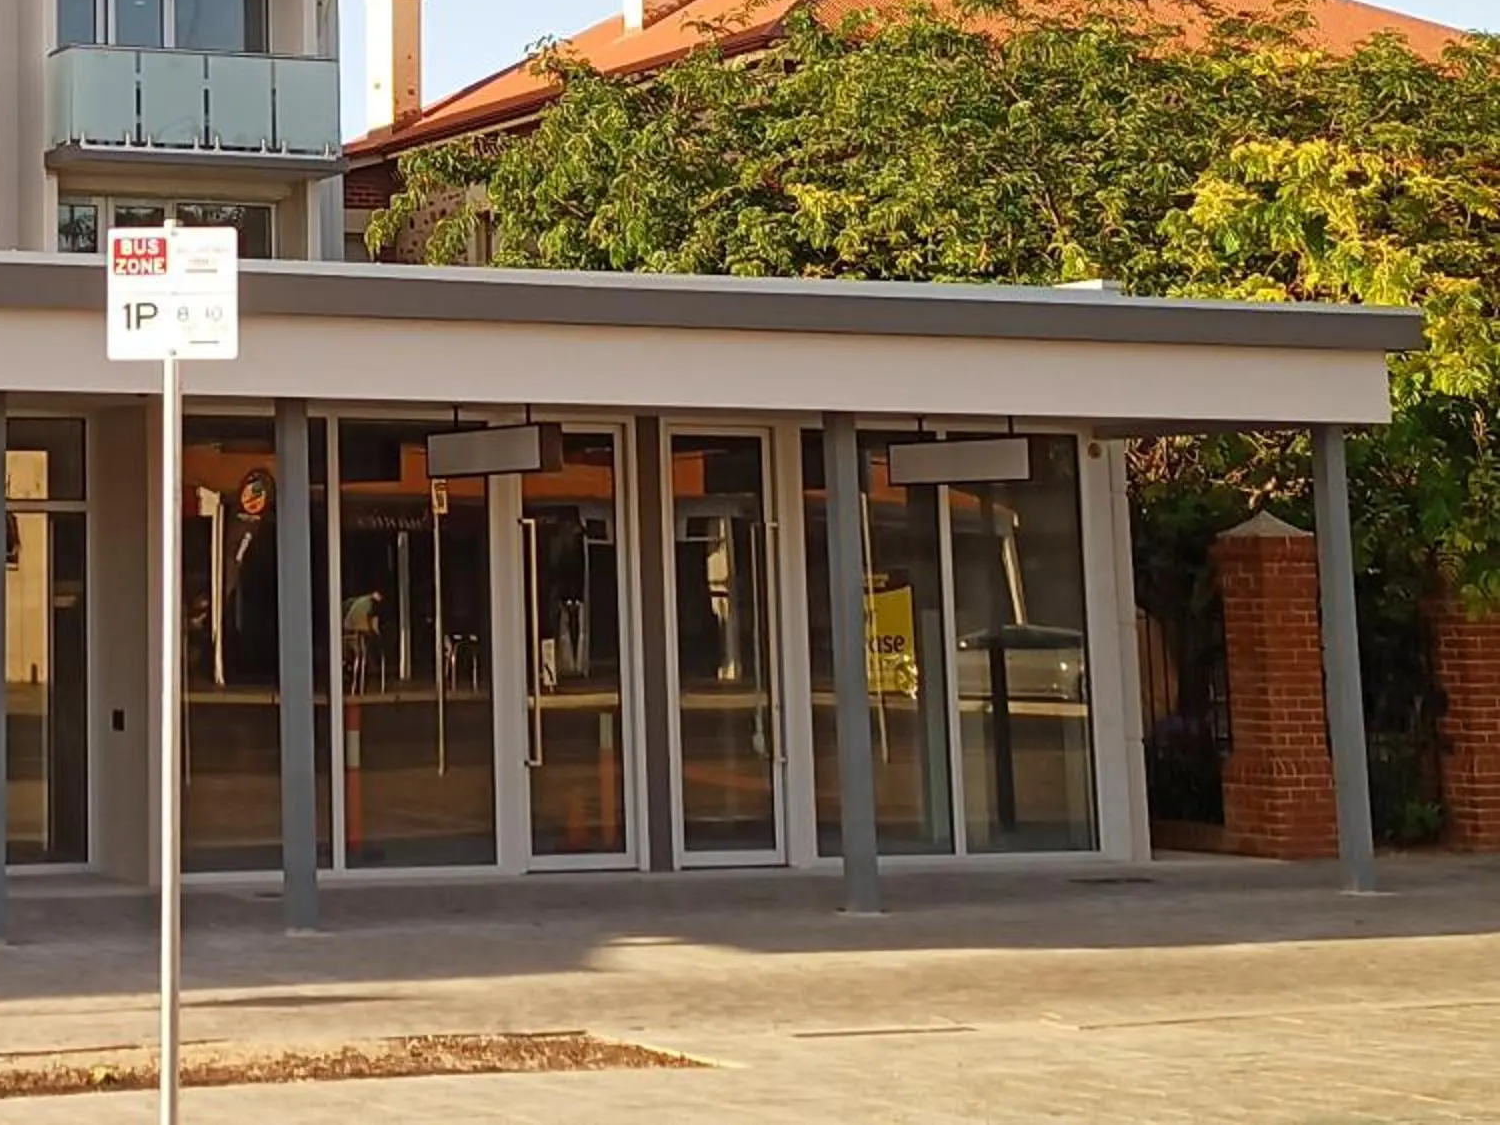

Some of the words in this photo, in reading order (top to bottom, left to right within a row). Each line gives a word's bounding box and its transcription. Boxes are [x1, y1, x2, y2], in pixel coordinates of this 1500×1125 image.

[119, 237, 160, 256] BUS
[115, 257, 165, 275] ZONE
[122, 302, 158, 330] 1P
[868, 633, 905, 654] ase
